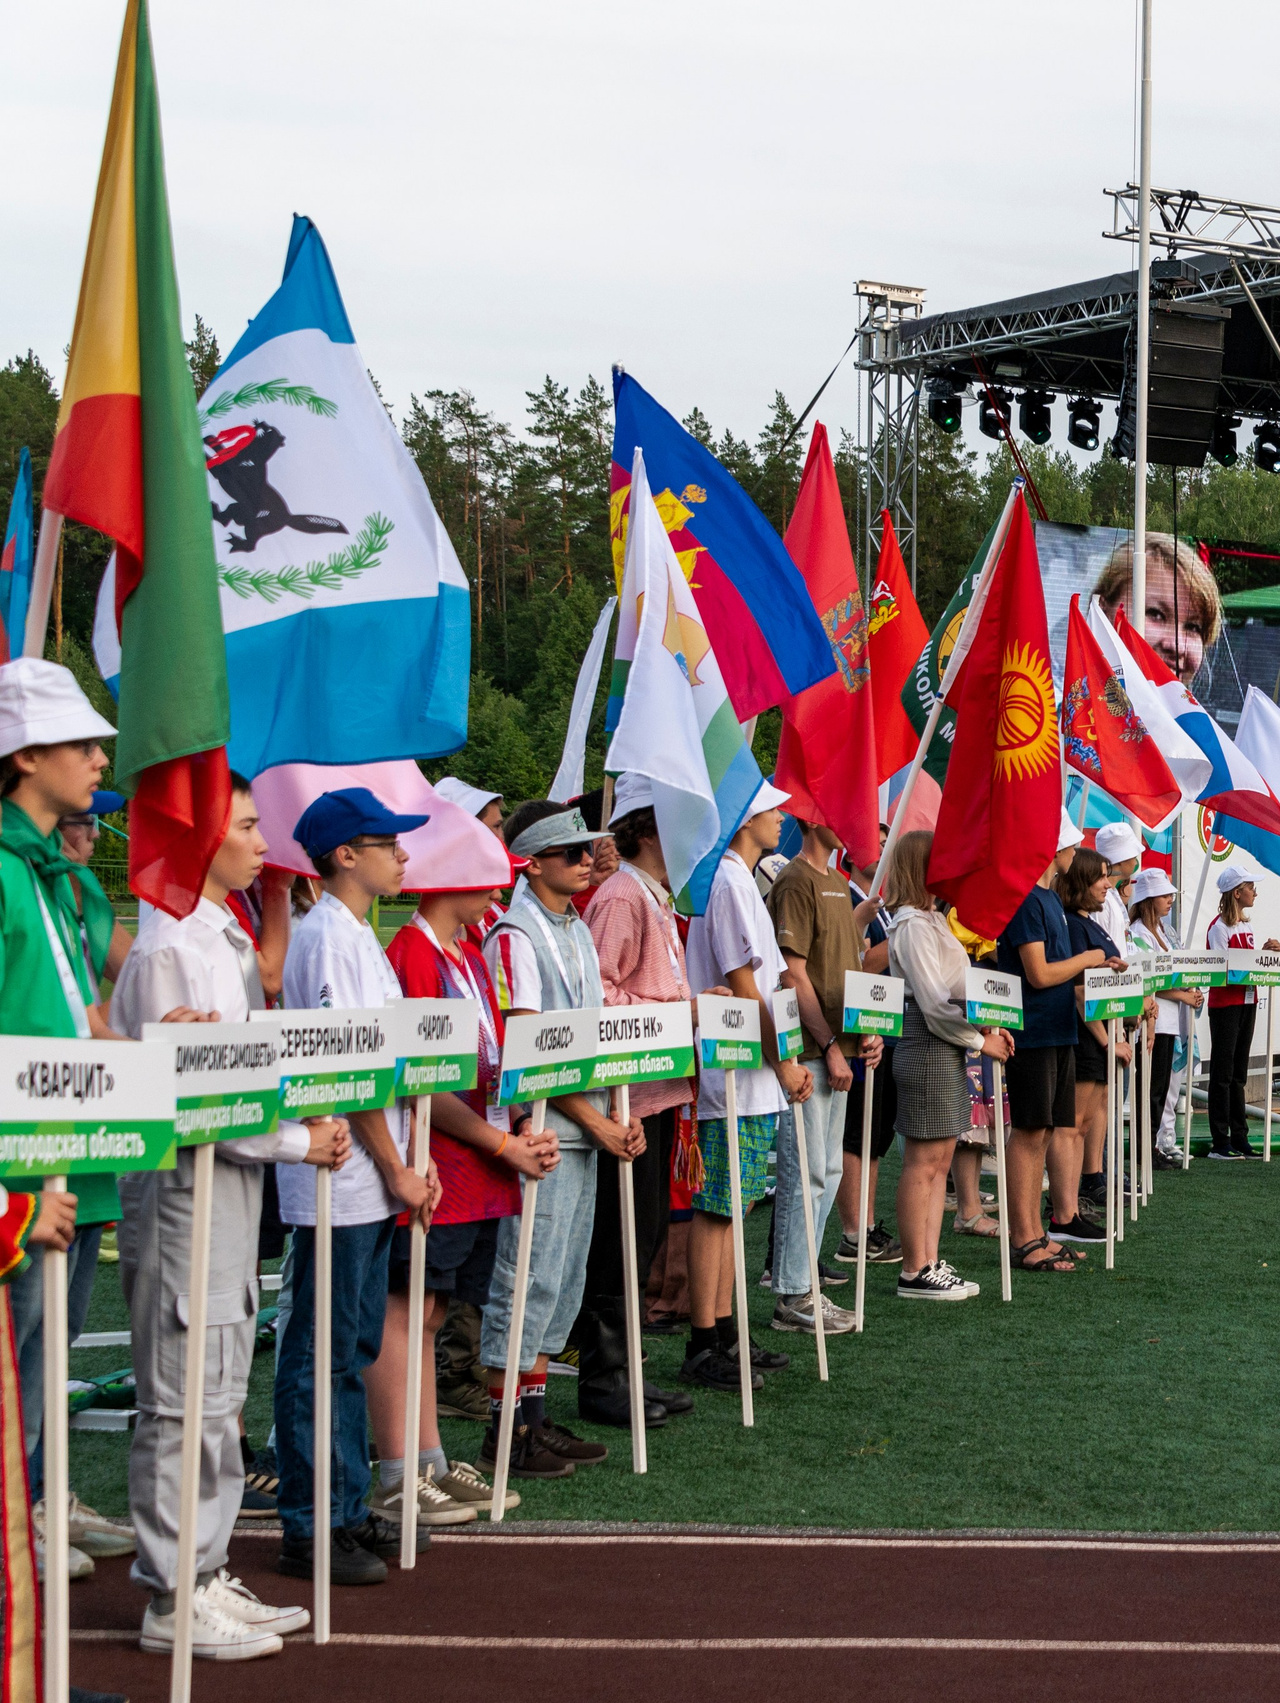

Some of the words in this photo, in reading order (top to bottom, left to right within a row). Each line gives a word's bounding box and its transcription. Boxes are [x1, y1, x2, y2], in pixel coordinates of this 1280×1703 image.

[356, 1019, 385, 1052] КРАЙ»
[418, 1015, 453, 1040] «ЧАРОИТ»
[535, 1026, 574, 1051] «КУЗБАСС»
[600, 1018, 640, 1042] ЕОКЛУБ
[643, 1017, 663, 1038] НК»
[176, 1044, 228, 1075] ДИМИРСКИЕ
[230, 1043, 277, 1070] САМОЦВЕТЫ»
[438, 1059, 461, 1082] область
[640, 1054, 674, 1074] область
[16, 1061, 115, 1104] «КВАРЦИТ»
[284, 1075, 354, 1108] Забайкальский
[356, 1074, 376, 1105] край
[518, 1072, 558, 1096] Кемеровская
[558, 1066, 582, 1087] область
[175, 1106, 230, 1136] адимирская
[232, 1098, 264, 1126] область
[89, 1126, 145, 1160] область
[527, 1386, 545, 1394] FIL
